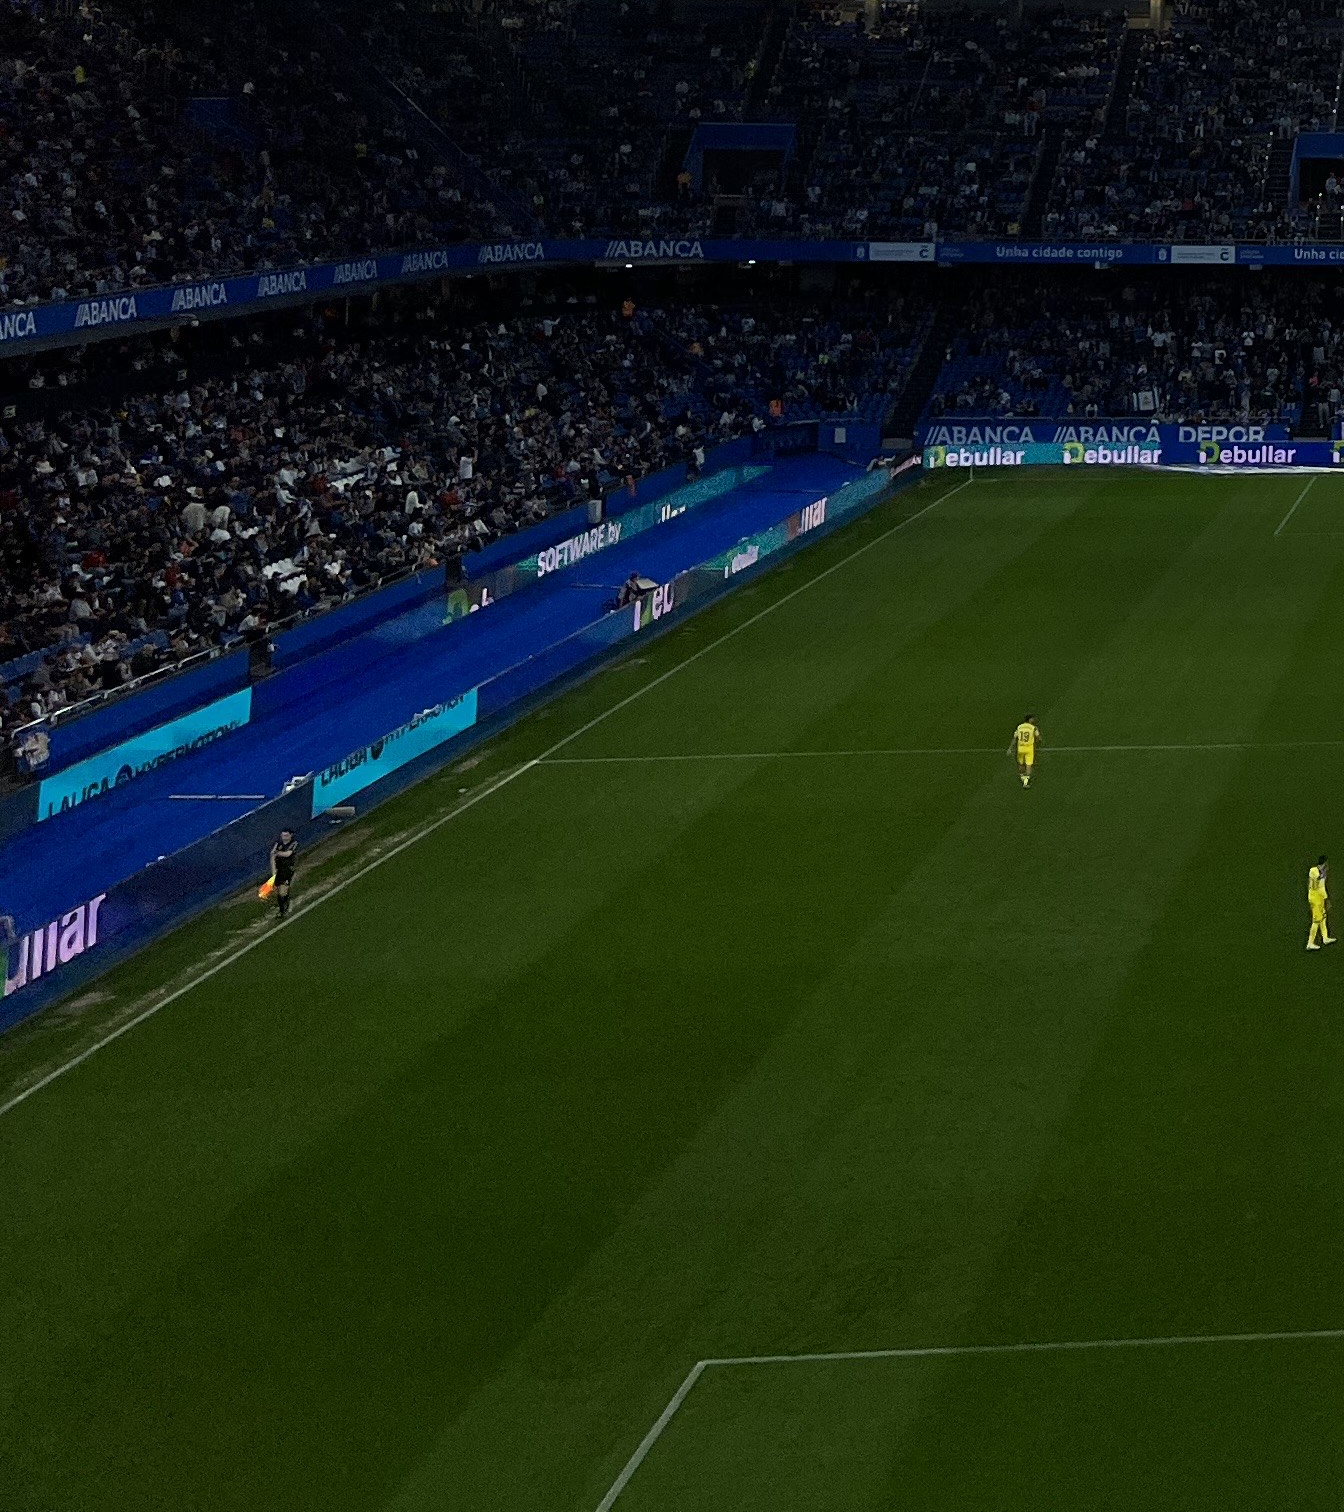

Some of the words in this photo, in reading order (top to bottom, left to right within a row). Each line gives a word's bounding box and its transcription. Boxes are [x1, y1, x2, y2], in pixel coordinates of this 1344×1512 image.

[996, 244, 1029, 258] Unha
[1032, 244, 1074, 259] cidade
[1077, 245, 1124, 261] contigo
[1294, 247, 1326, 261] Unha
[1179, 426, 1264, 443] DEPOR
[537, 524, 606, 577] SOFTWARE
[608, 521, 622, 545] by
